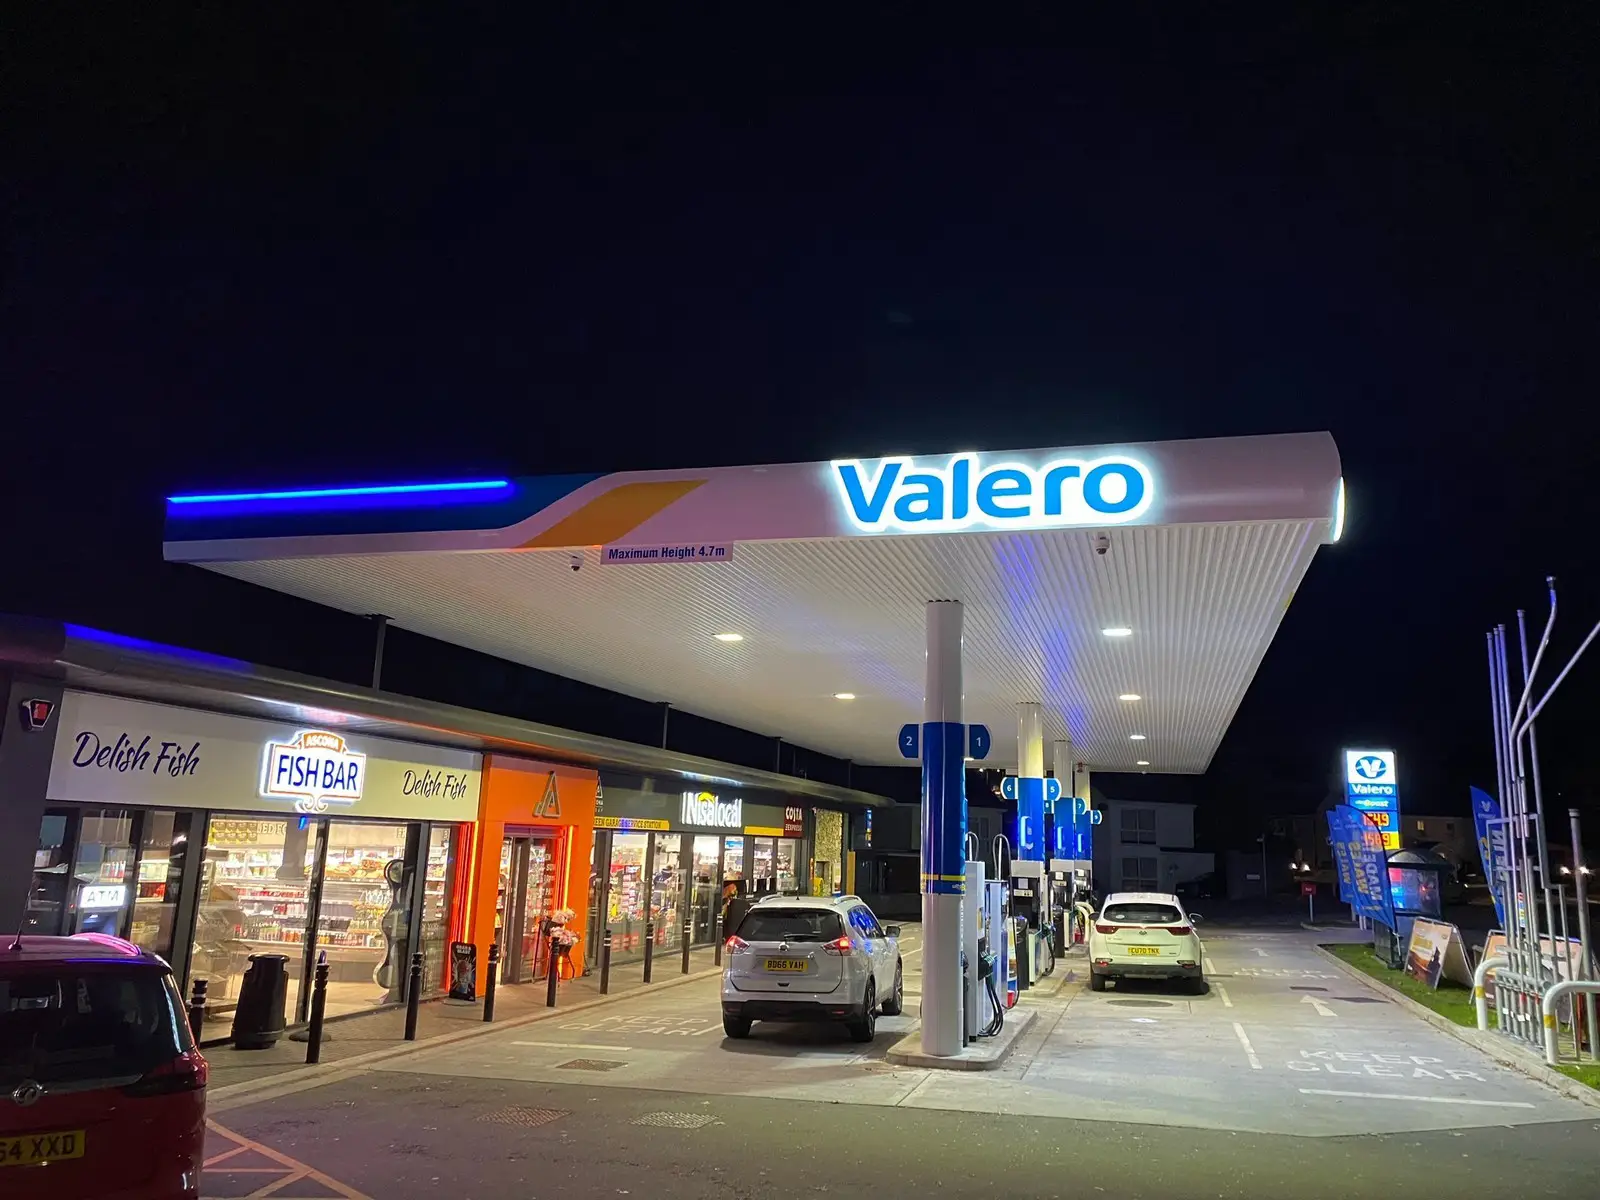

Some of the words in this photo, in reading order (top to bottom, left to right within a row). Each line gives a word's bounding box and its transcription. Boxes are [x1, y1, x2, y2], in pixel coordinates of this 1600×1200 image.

[837, 459, 1145, 523] Valero
[608, 548, 658, 560] Maximum
[661, 547, 695, 559] Height
[698, 545, 725, 557] 4.7m
[905, 735, 913, 746] 2
[975, 736, 982, 747] 1
[72, 731, 151, 773] Delish
[152, 742, 201, 778] Fish
[276, 754, 320, 787] FISH
[322, 759, 358, 791] BAR
[402, 769, 442, 798] Delish
[442, 774, 467, 800] Fish
[1050, 785, 1056, 793] 5
[1351, 783, 1393, 795] Valero
[785, 805, 802, 822] COSTA
[600, 1015, 708, 1026] KEEP
[558, 1023, 697, 1036] CLEAR
[1300, 1050, 1444, 1065] KEEP
[1287, 1060, 1487, 1082] CLEAR
[30, 1134, 75, 1159] XXD
